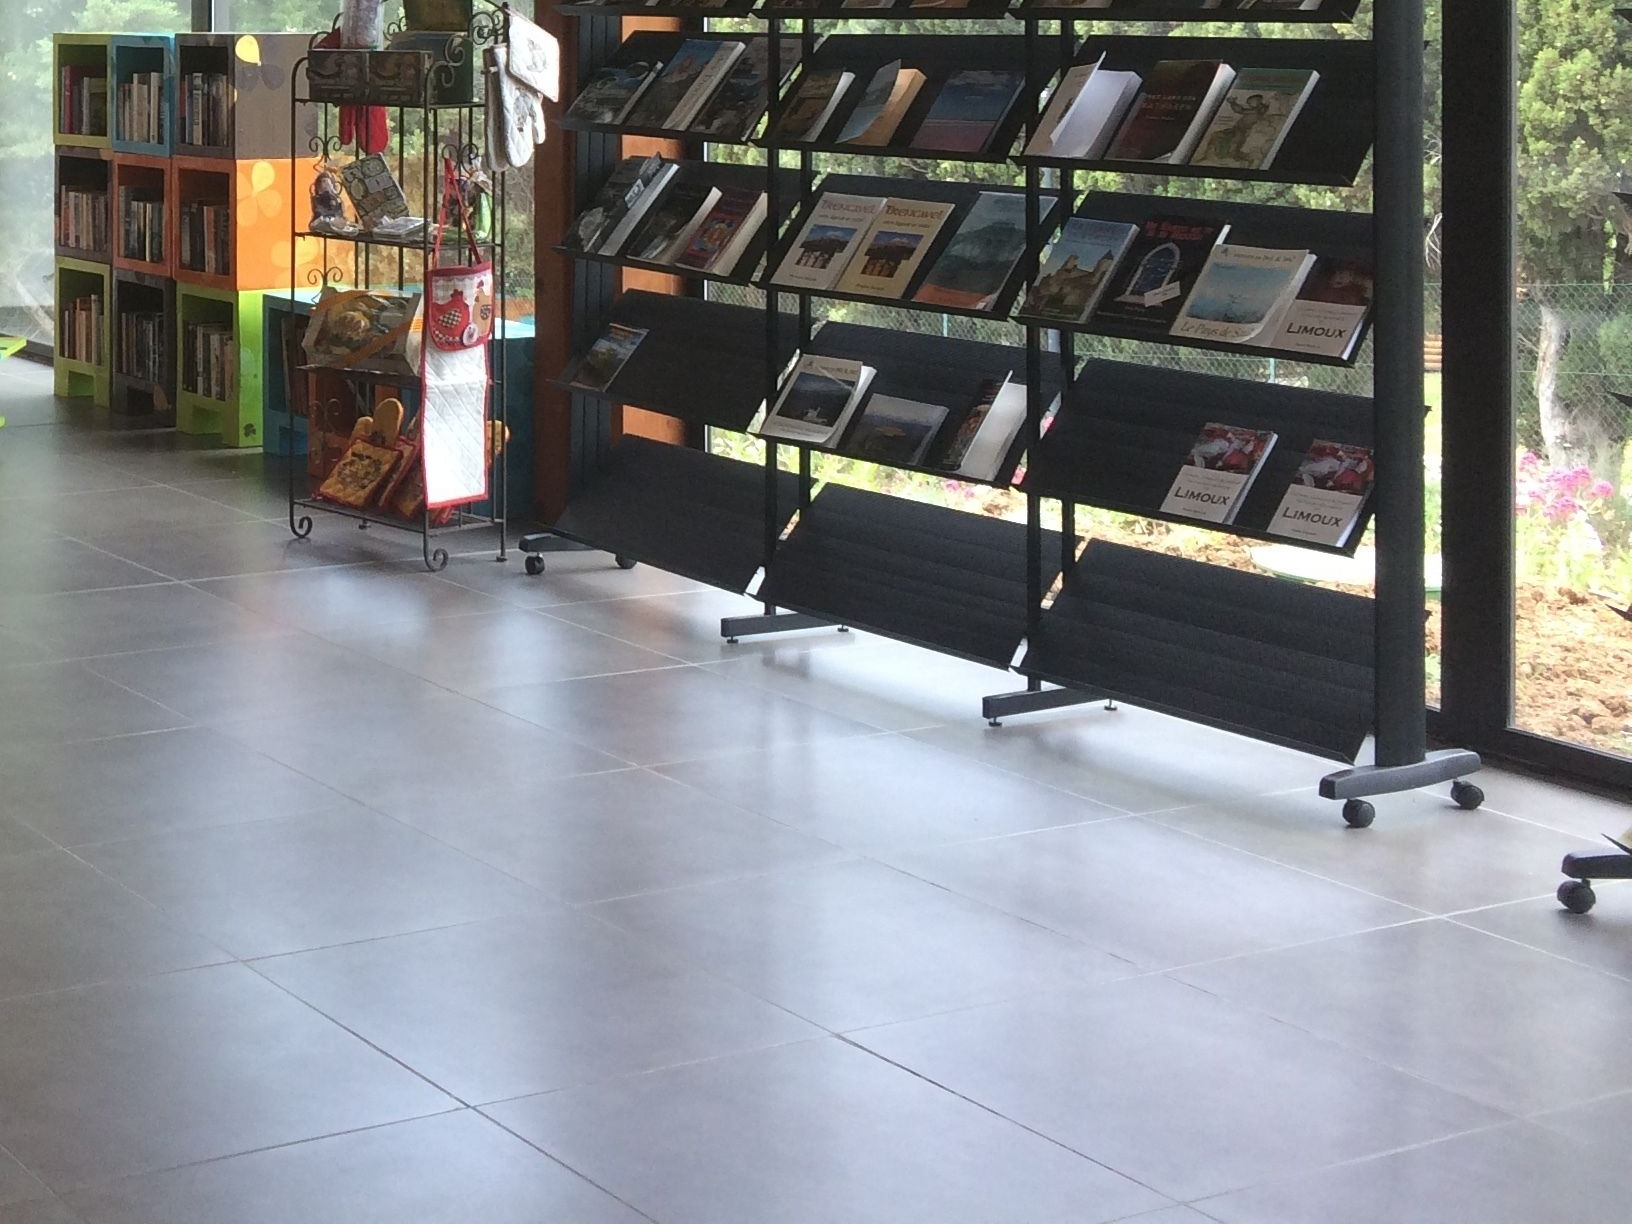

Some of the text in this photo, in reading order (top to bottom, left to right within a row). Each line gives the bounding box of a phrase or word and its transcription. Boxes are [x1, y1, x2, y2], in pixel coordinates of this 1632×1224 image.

[1286, 321, 1346, 339] LIMOUX
[1174, 486, 1231, 506] LIMOUX
[1282, 506, 1344, 528] LIMOUX
